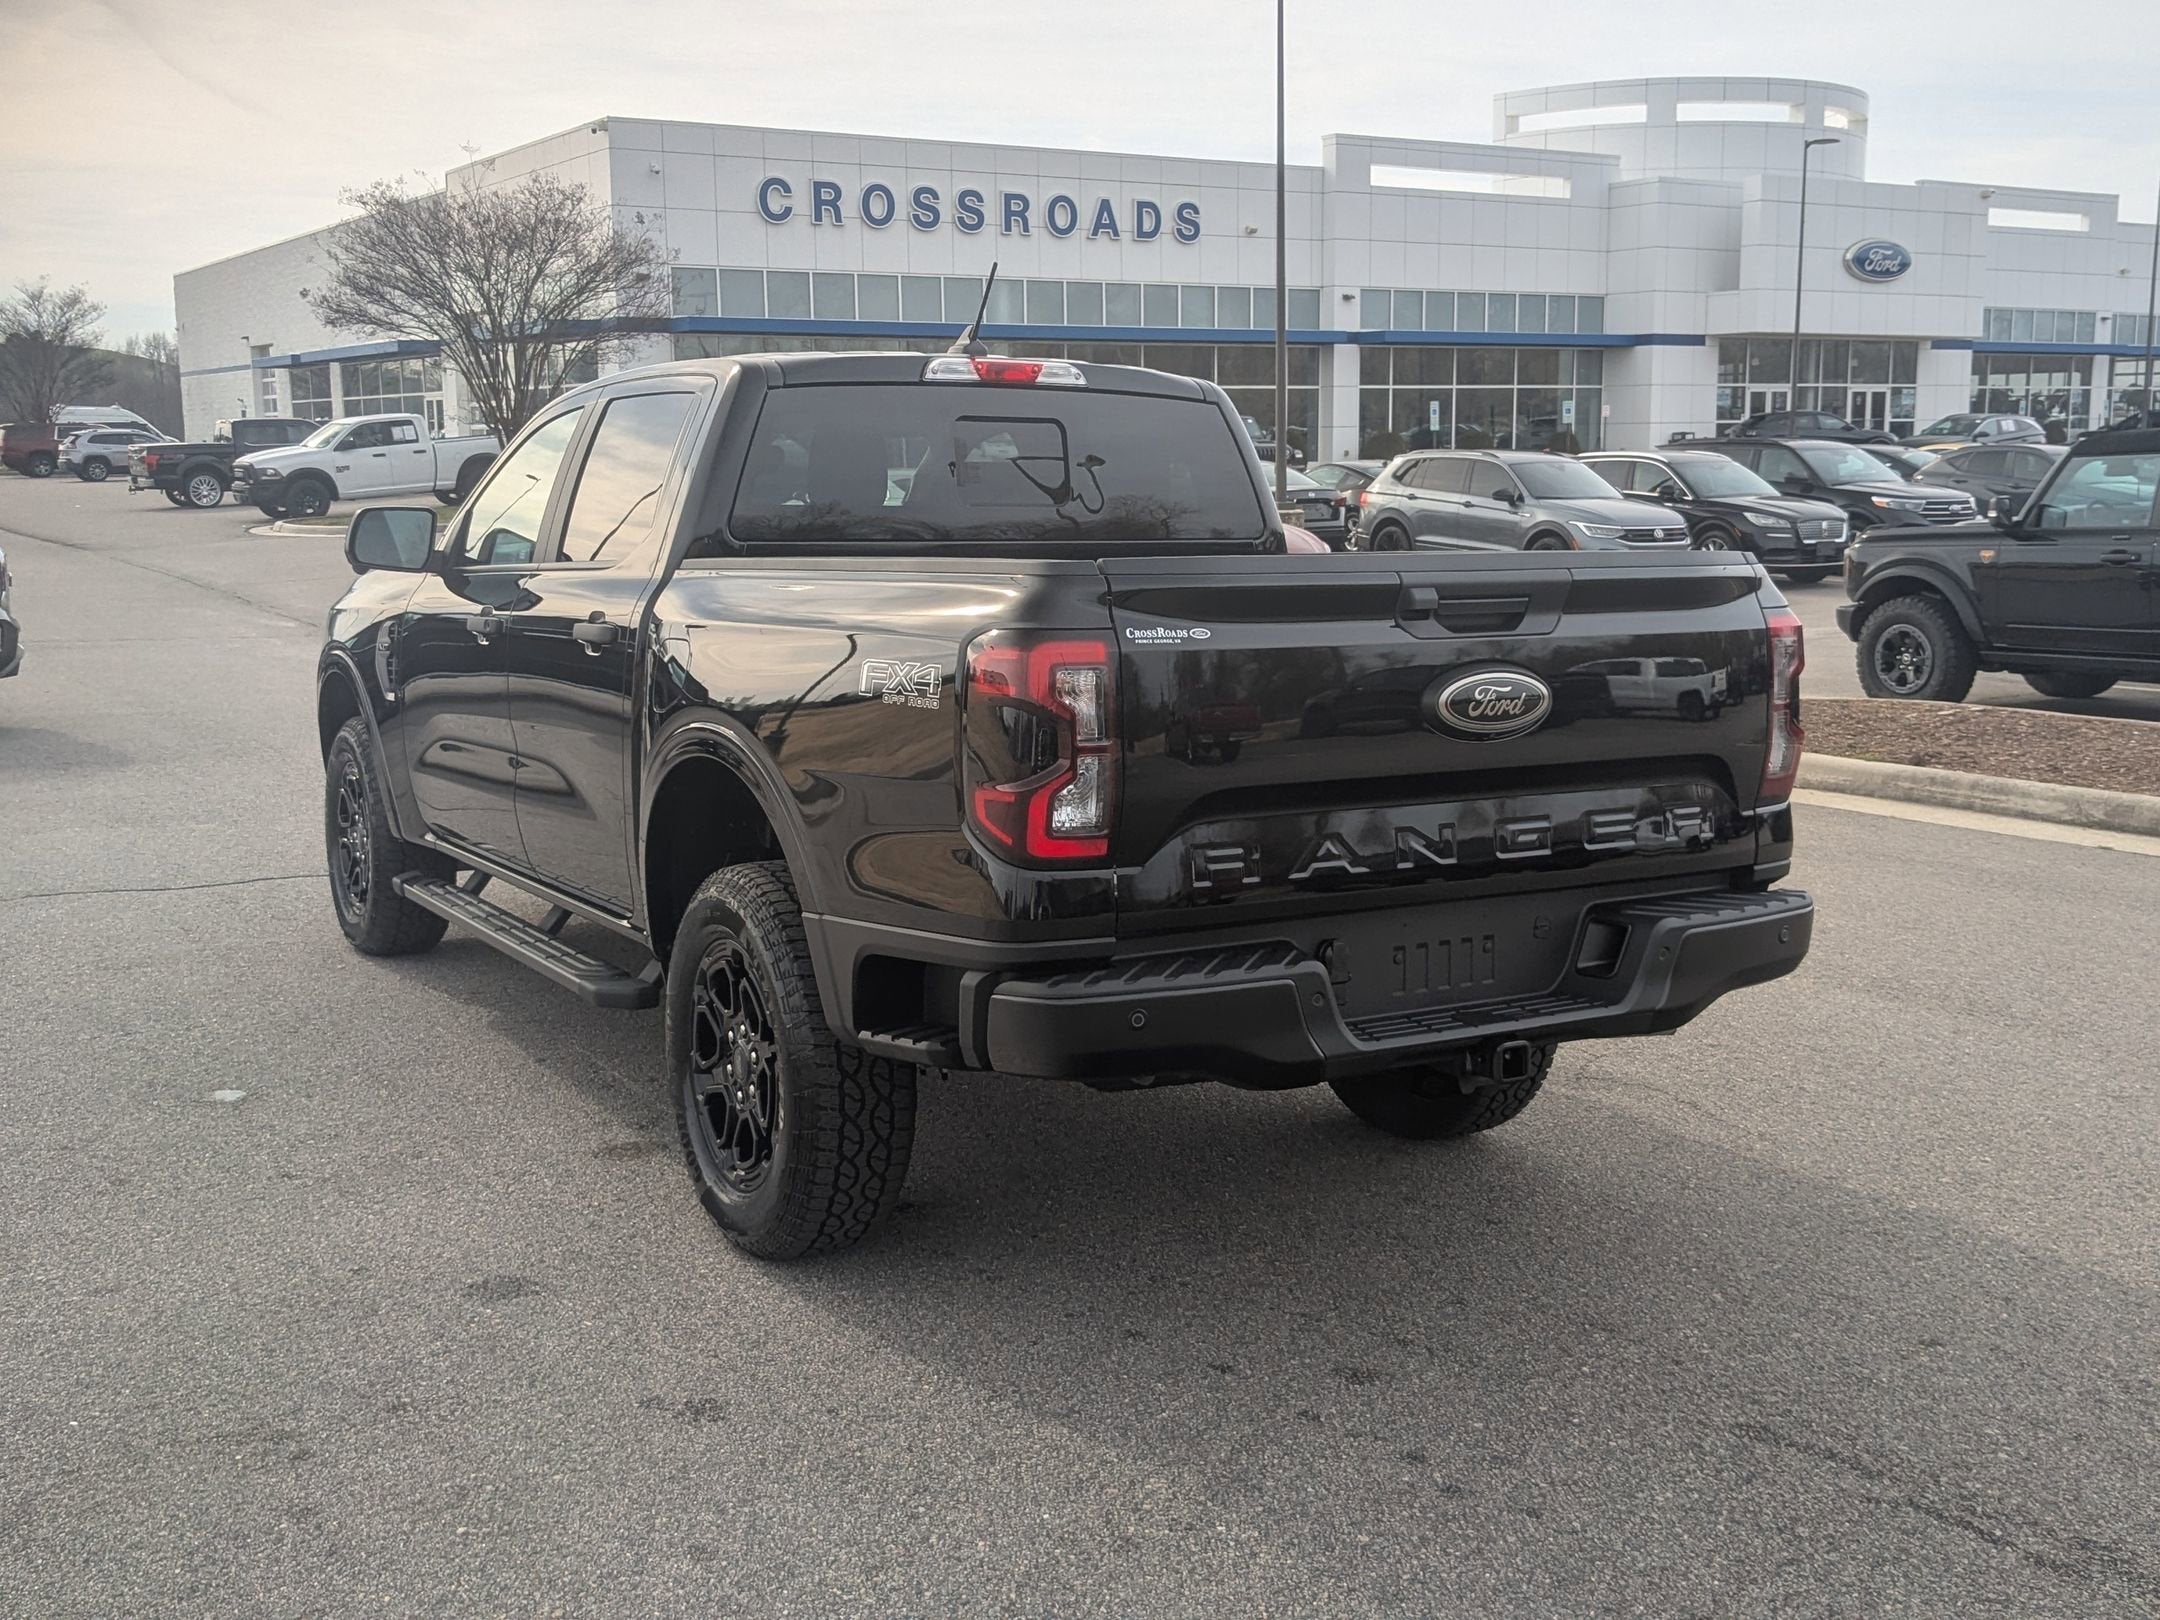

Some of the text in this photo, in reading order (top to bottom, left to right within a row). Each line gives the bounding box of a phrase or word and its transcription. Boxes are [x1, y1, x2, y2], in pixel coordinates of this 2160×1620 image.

[756, 175, 1202, 244] CROSSROADS
[1864, 248, 1902, 272] Ford
[859, 659, 942, 698] FX4
[882, 694, 940, 710] OFF ROAD
[1468, 685, 1527, 718] Ford
[1188, 806, 1716, 888] RANGER
